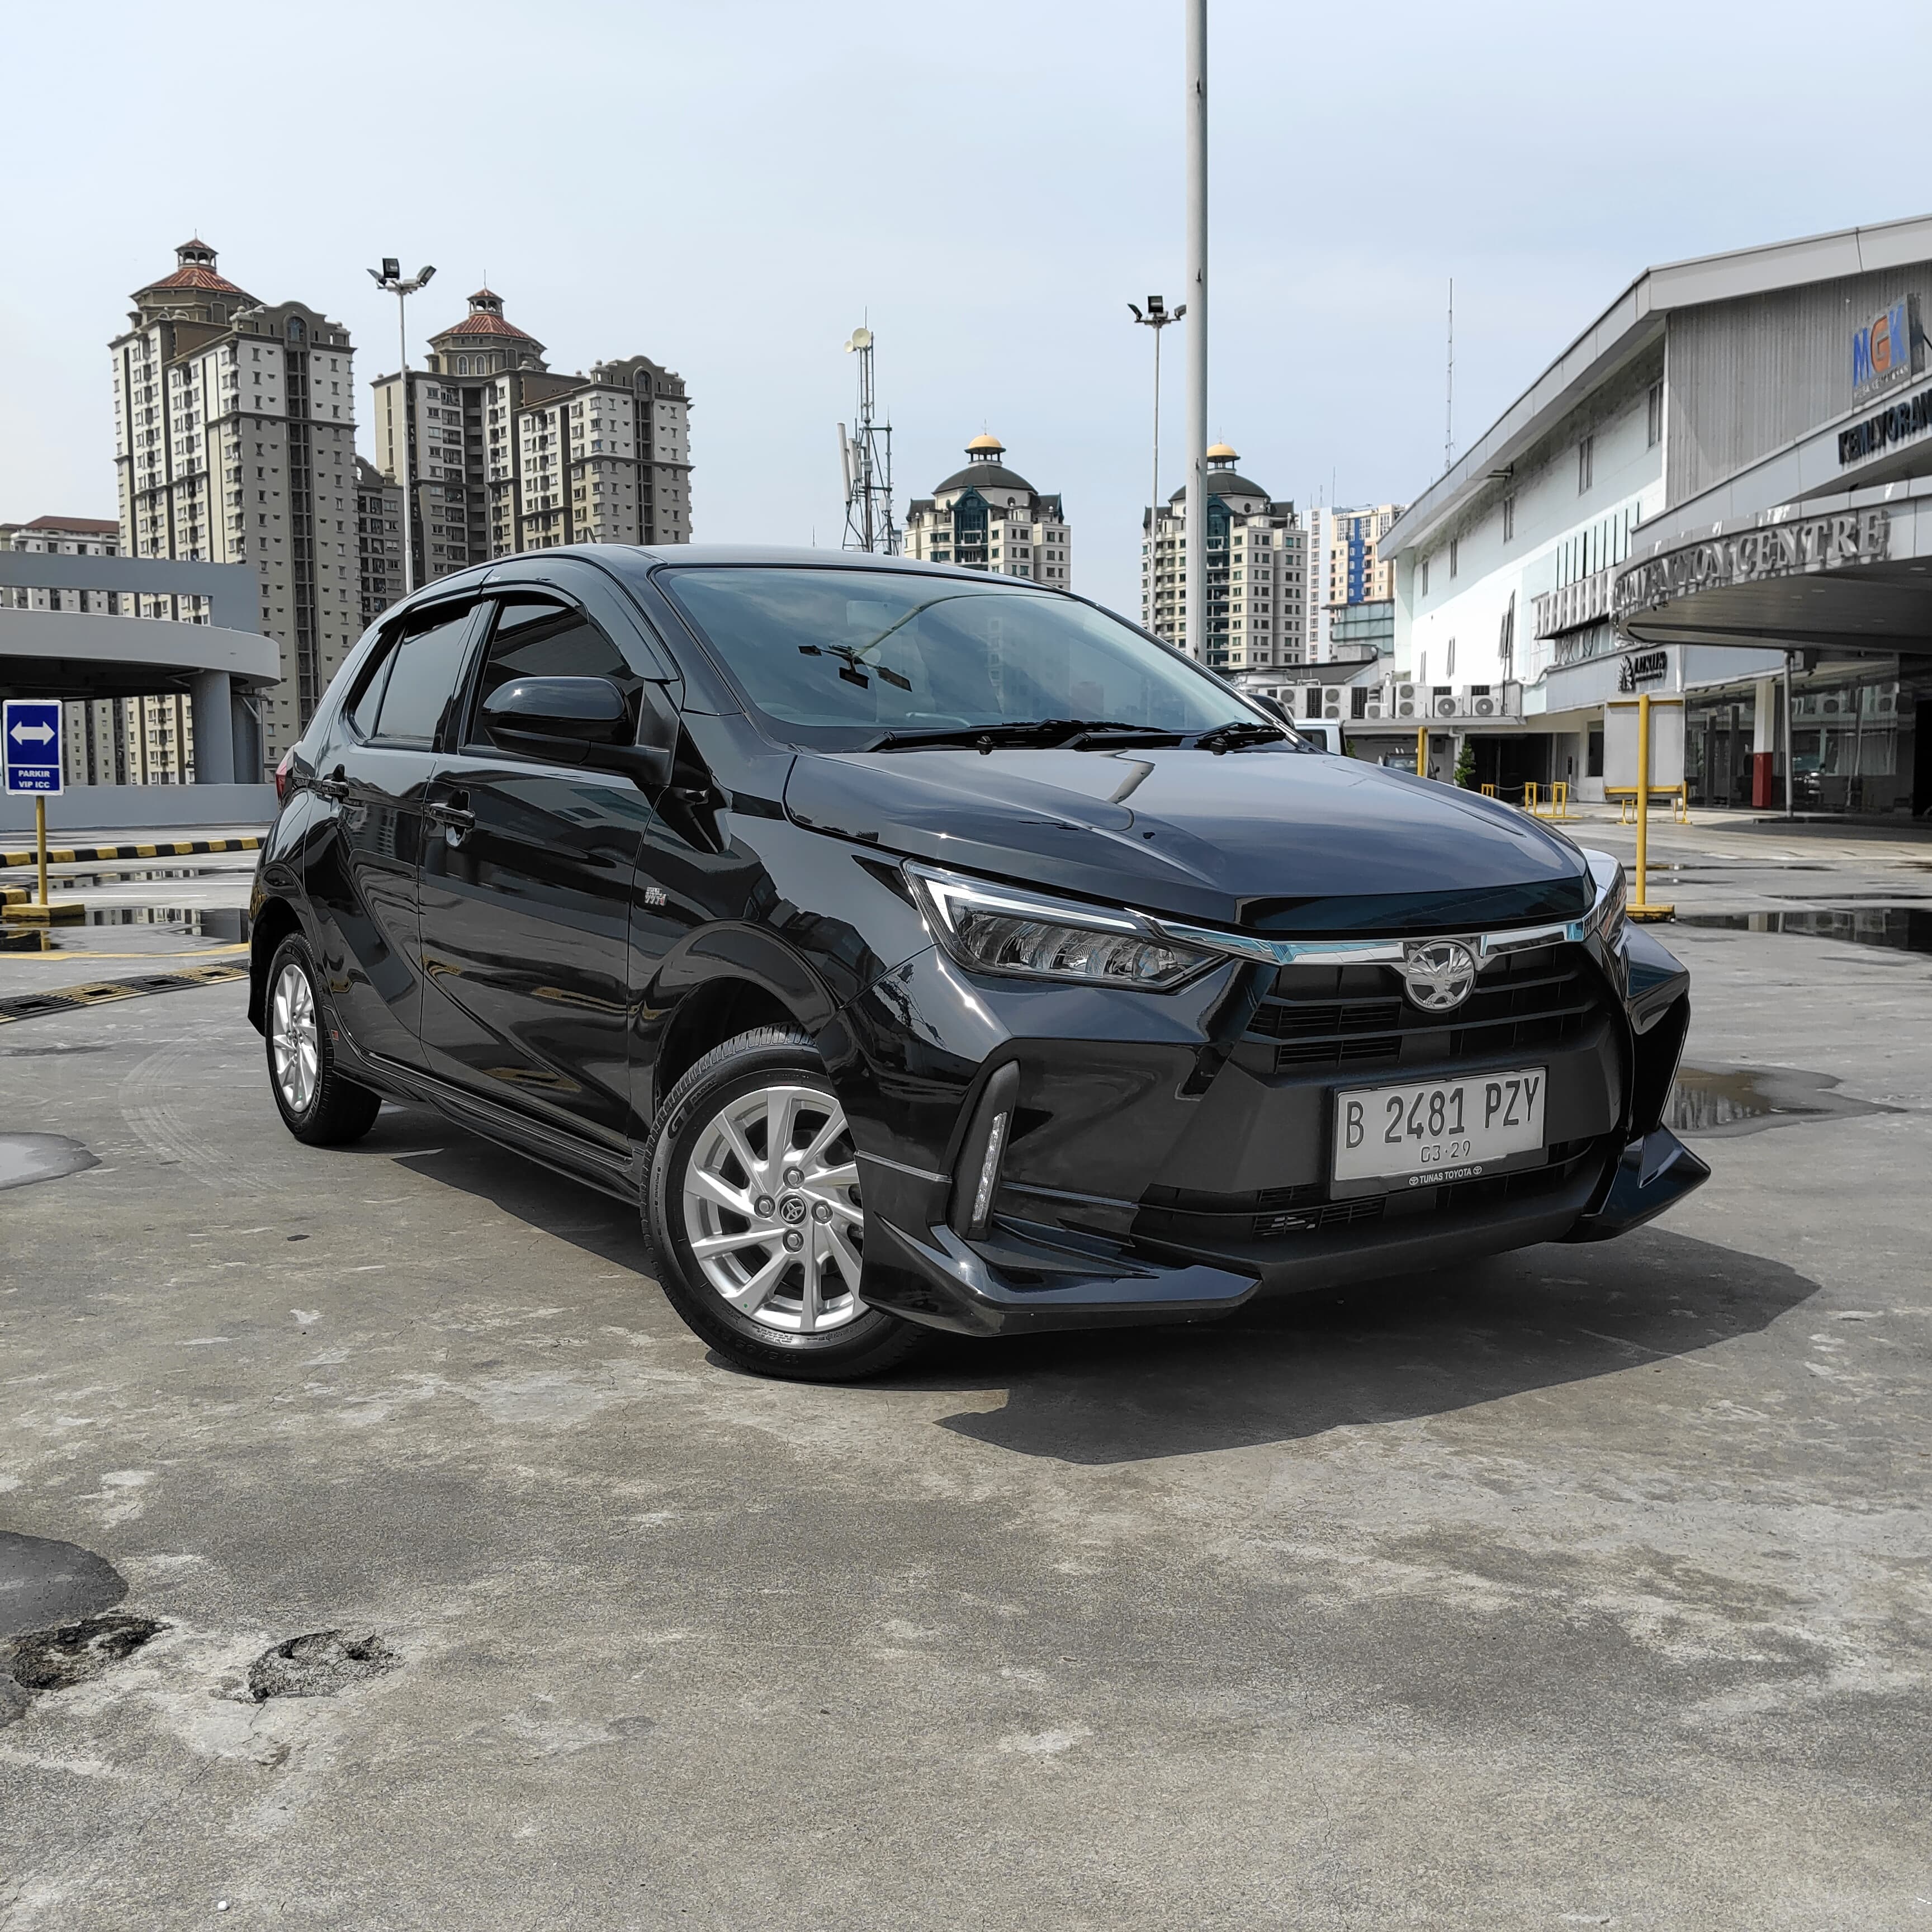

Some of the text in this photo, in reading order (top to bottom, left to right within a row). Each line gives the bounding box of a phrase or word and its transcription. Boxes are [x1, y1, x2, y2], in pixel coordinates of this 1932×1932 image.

[1853, 305, 1907, 387] MGK
[1733, 509, 1888, 571] CENTRE
[1346, 1077, 1539, 1148] B 2481 PZY
[1419, 1168, 1472, 1184] TUNAS TOYOTA
